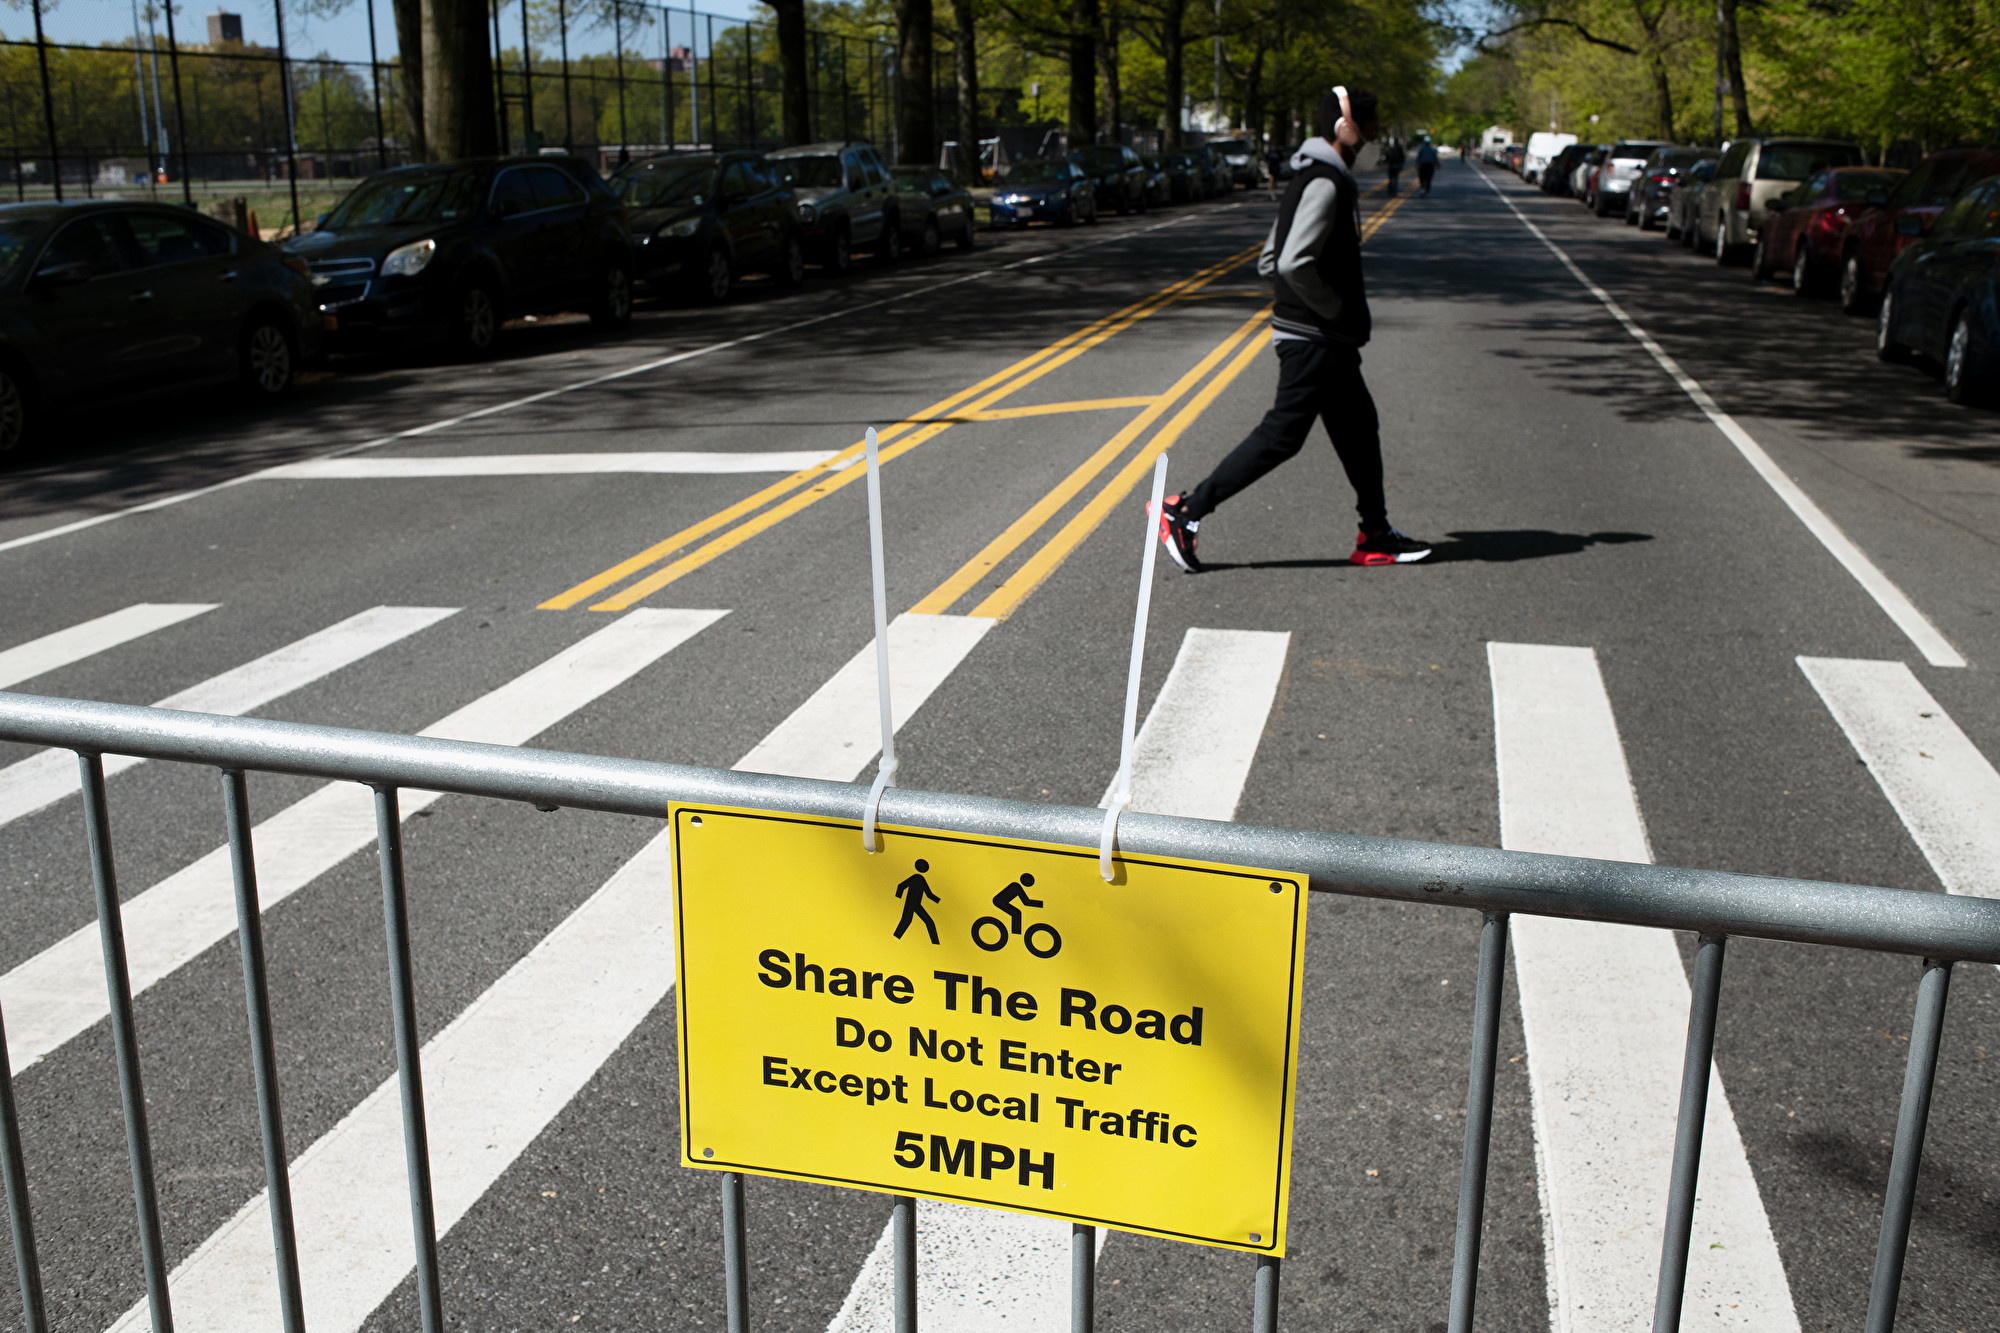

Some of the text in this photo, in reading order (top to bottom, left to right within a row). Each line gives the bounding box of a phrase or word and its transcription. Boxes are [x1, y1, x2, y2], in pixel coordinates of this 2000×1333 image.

[758, 949, 1204, 1047] Share The Road
[836, 1017, 1122, 1086] Do Not Enter
[762, 1055, 1198, 1148] Except Local Traffic
[893, 1130, 1055, 1191] 5MPH
